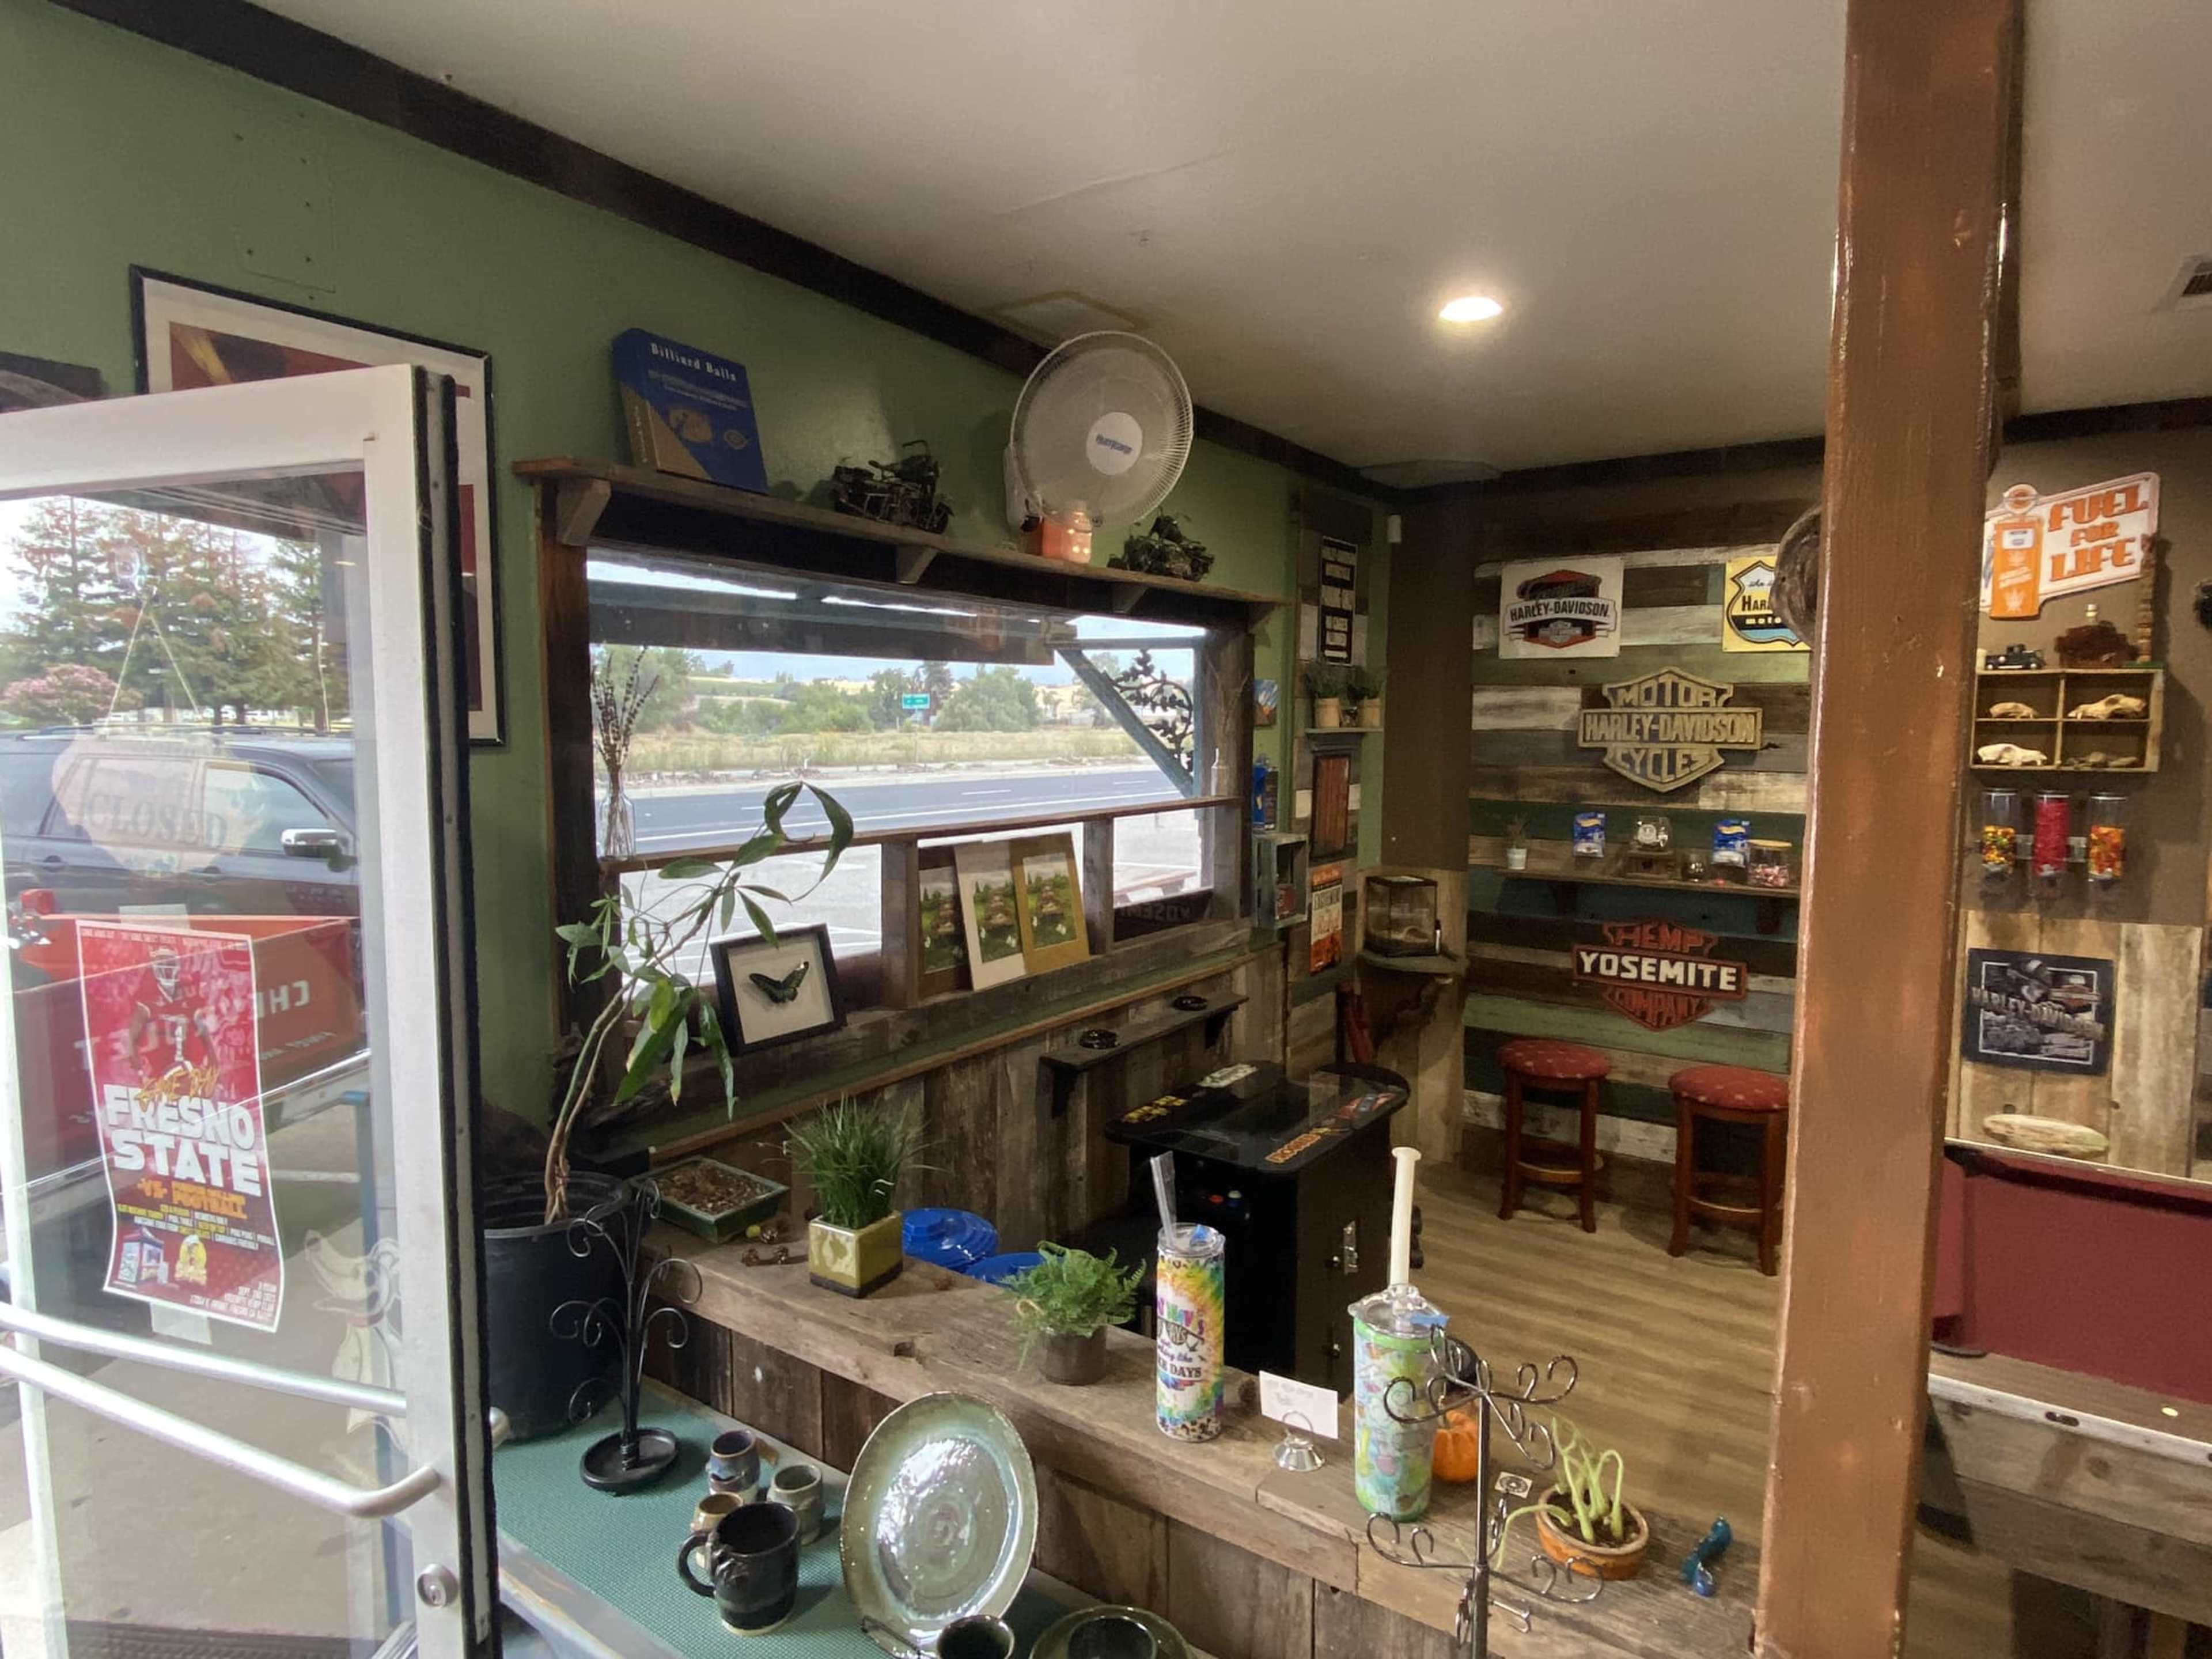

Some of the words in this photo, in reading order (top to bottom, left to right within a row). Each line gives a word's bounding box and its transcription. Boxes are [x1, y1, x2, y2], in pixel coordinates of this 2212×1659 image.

[650, 343, 700, 370] Billiard
[706, 362, 737, 381] Balls
[2048, 484, 2149, 532] FUEL
[2070, 521, 2119, 547] FOR
[2050, 537, 2135, 582] LIFE
[1510, 600, 1609, 622] HARLEY-DAVIDSON
[1742, 595, 1770, 612] HAR
[1616, 675, 1717, 707] MOTOR
[1585, 713, 1755, 743] HARLEY-DAVIDSON
[1615, 748, 1711, 782] CYCLES
[1615, 923, 1705, 953] HEMP
[1579, 951, 1737, 991] YOSEMITE
[103, 1084, 255, 1151] FRESNO
[112, 1129, 262, 1198] STATE
[1169, 1363, 1202, 1378] DAYS
